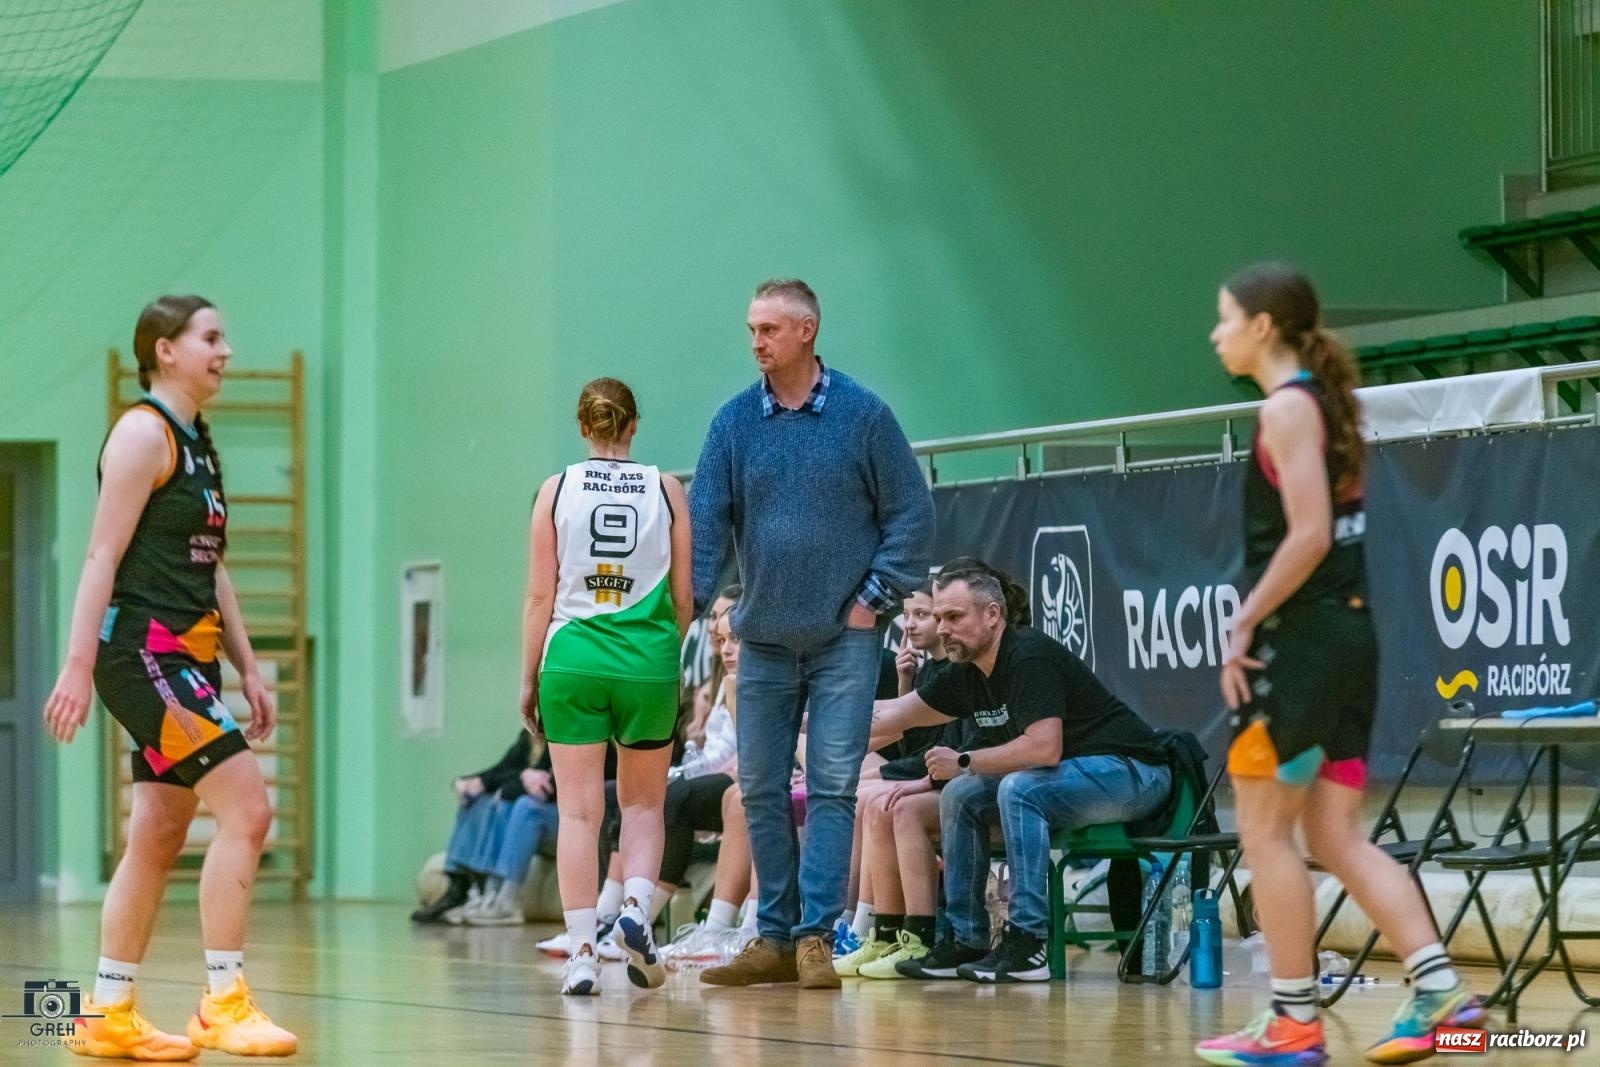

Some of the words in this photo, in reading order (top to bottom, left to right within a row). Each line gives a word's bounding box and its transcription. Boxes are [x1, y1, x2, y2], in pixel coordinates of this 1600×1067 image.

[583, 482, 645, 494] RACIBÓRZ
[585, 470, 611, 481] RKK
[620, 472, 644, 480] AZS
[590, 504, 638, 558] 9
[588, 576, 631, 590] SEGET
[1123, 584, 1241, 670] RACIB
[1487, 652, 1571, 696] RACIBÓRZ
